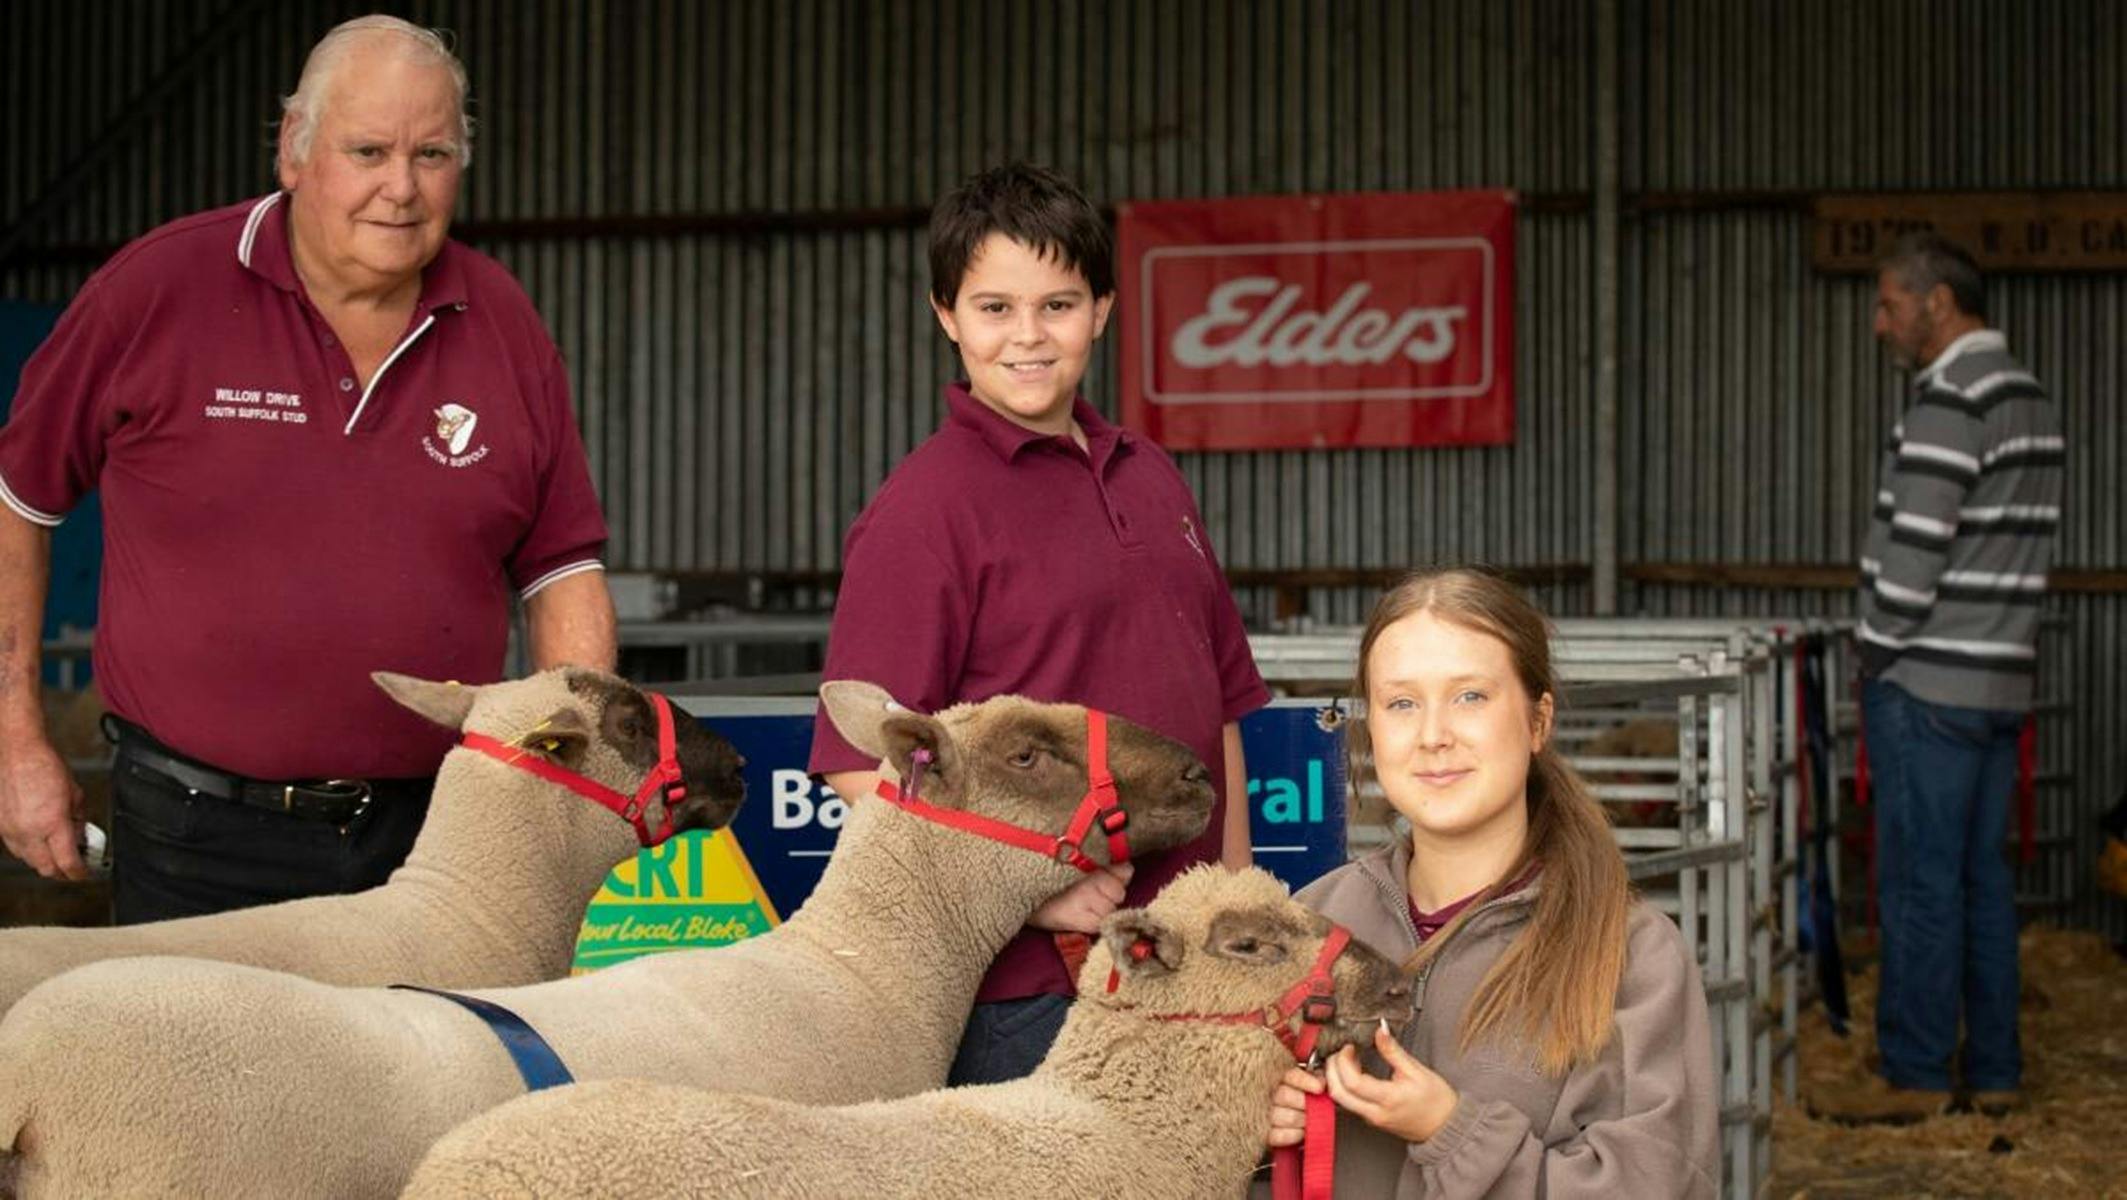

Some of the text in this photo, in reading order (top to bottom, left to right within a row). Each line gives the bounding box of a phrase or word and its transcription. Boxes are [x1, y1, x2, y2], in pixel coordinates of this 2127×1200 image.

[1171, 276, 1469, 369] Elders
[215, 388, 301, 407] WILLOW DRIVE
[204, 405, 307, 423] SOUTH SUFFOLK STUD
[421, 435, 490, 468] SOUTH SUFFOLK
[618, 915, 683, 942] Local
